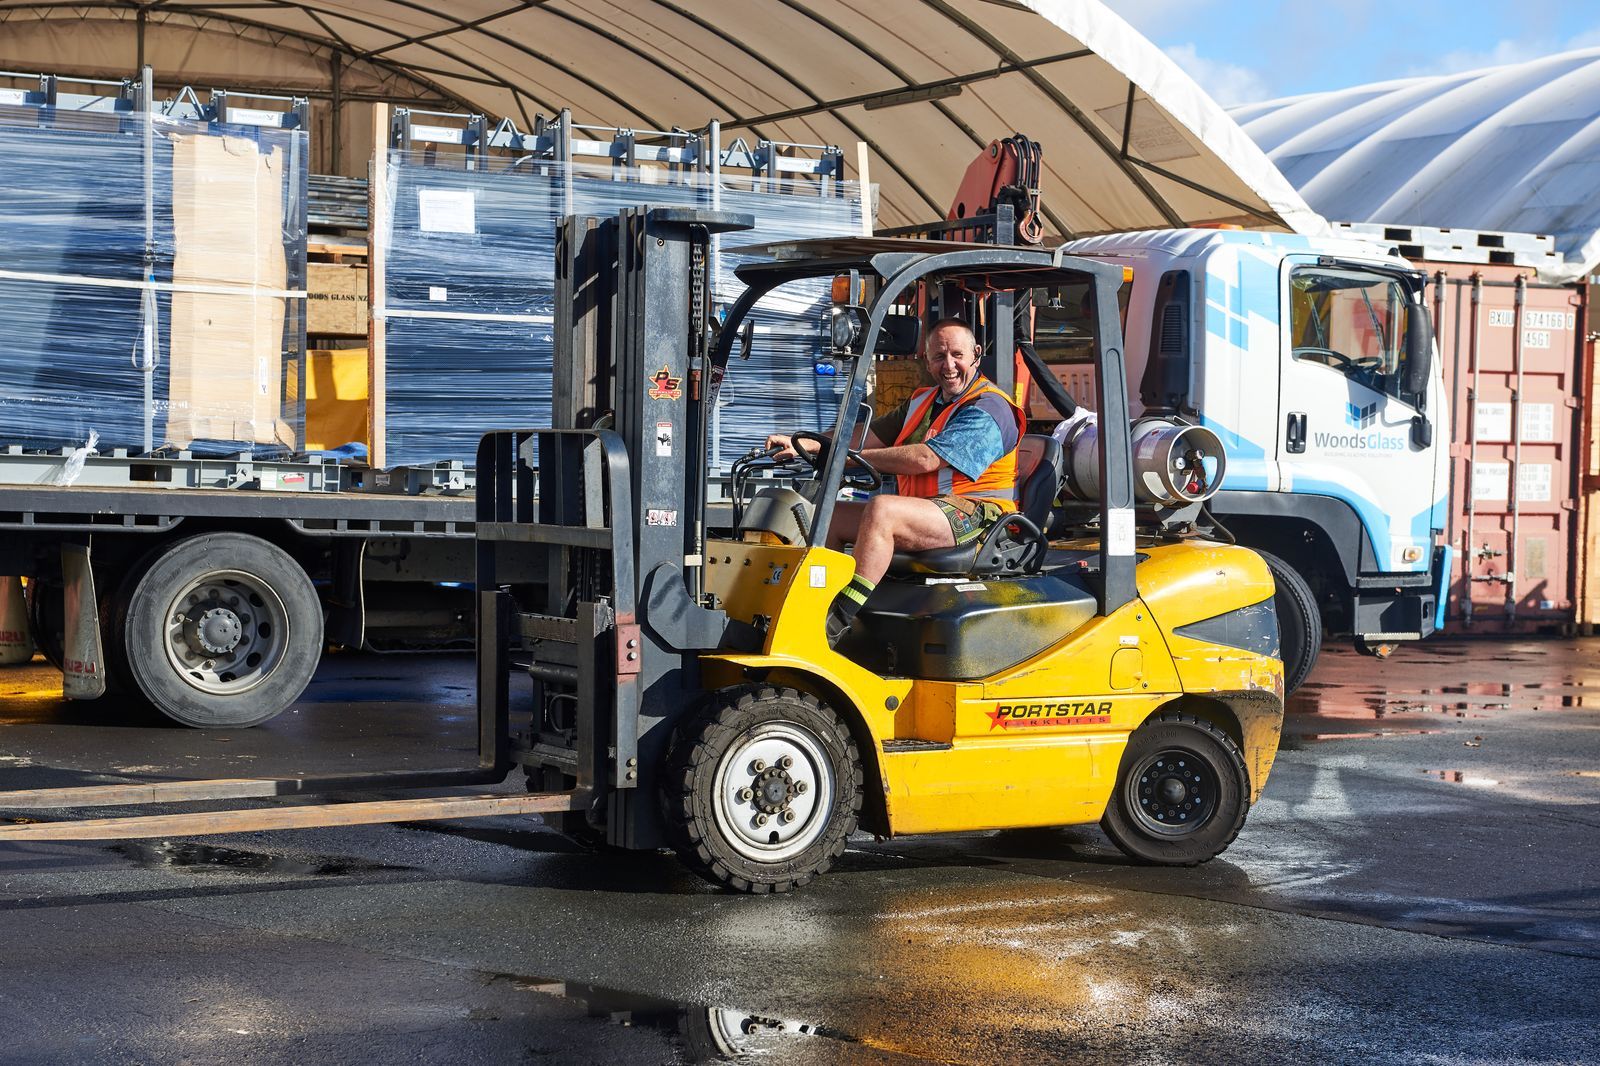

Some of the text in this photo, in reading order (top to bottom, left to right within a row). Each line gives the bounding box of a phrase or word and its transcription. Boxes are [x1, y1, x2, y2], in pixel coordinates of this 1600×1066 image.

[1490, 311, 1514, 325] BXUU
[1526, 313, 1562, 328] 574166
[1525, 332, 1549, 346] 45G1
[1314, 431, 1404, 450] WoodsGlass
[997, 702, 1113, 719] PORTSTAR
[1004, 717, 1106, 727] FRKLIFTS
